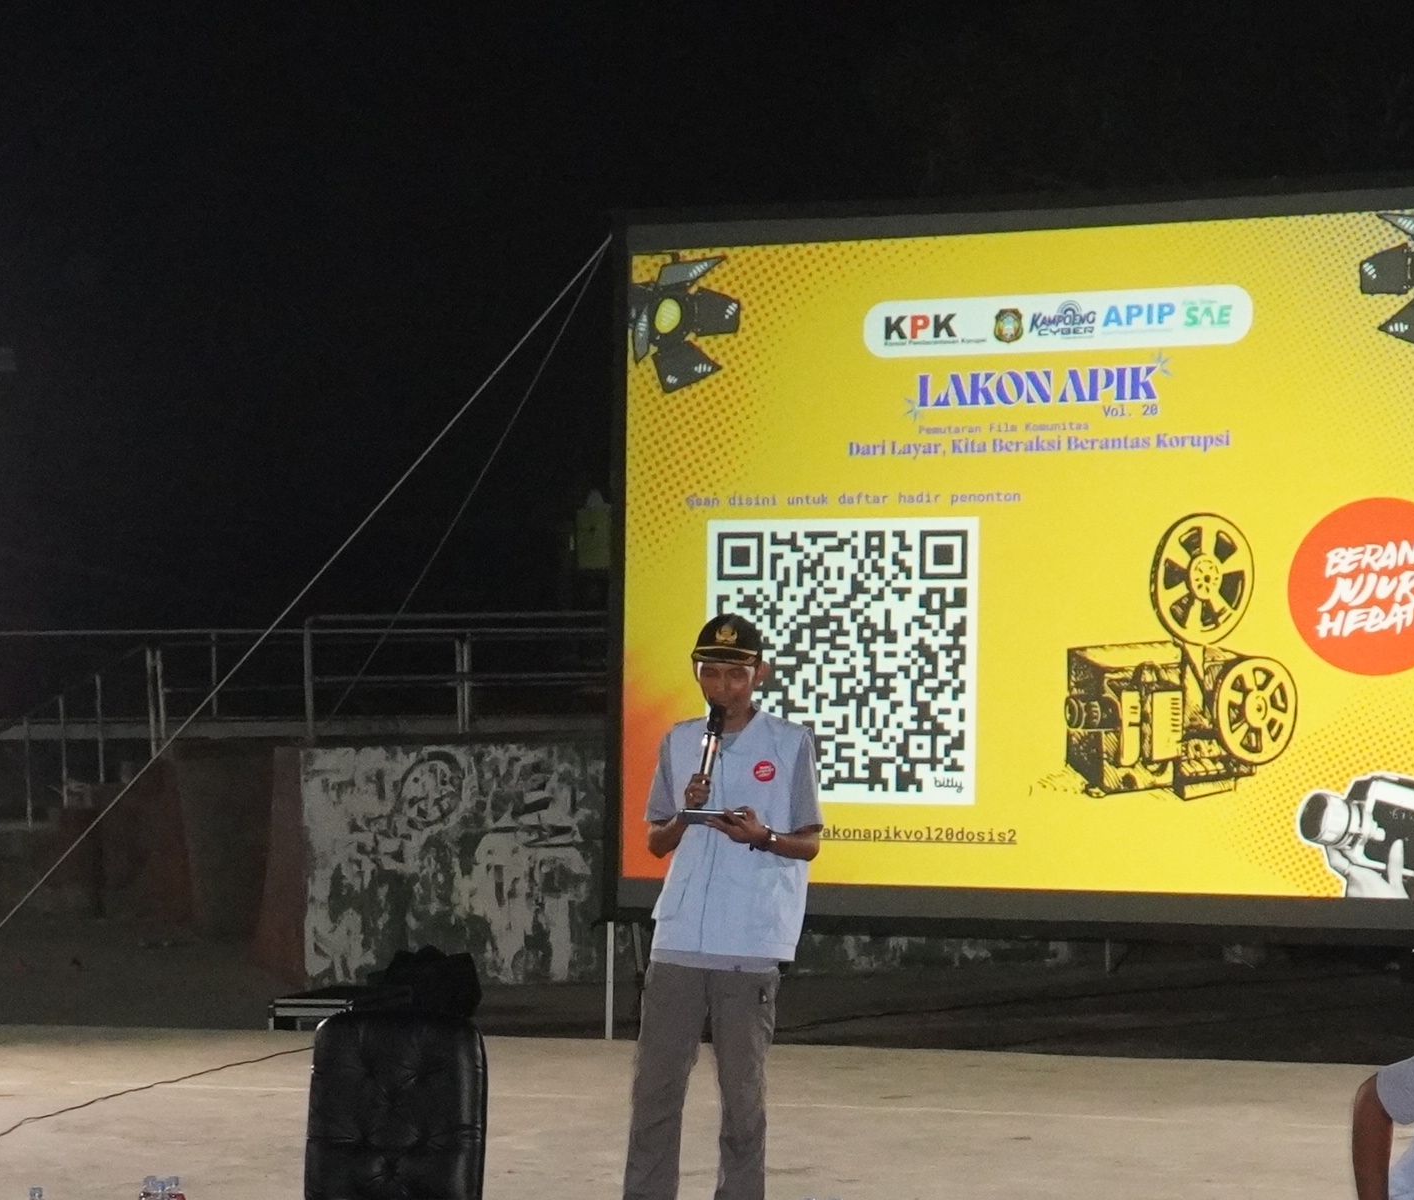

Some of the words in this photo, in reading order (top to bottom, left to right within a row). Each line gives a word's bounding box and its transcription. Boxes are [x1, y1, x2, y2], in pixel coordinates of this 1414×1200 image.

[1029, 308, 1097, 333] KAMPOENG
[1102, 302, 1176, 327] APIP
[1183, 304, 1233, 327] SAE
[884, 313, 957, 340] KPK
[1037, 325, 1095, 337] CYBER
[917, 369, 1053, 407] LAKON
[1057, 365, 1159, 402] APIK
[1102, 405, 1133, 418] Vol.
[1141, 404, 1159, 416] 20
[918, 424, 982, 435] Pemutaran
[989, 423, 1017, 433] Film
[1024, 421, 1089, 432] Komunitas
[848, 440, 886, 456] Dari
[891, 440, 946, 460] Layar,
[951, 437, 987, 454] Kita
[992, 435, 1062, 453] Beraksi
[1066, 434, 1151, 452] Berantas
[1156, 430, 1230, 453] Korupsi
[728, 494, 778, 507] disini
[787, 493, 828, 506] untuk
[838, 492, 888, 505] daftar
[898, 491, 941, 504] hadir
[950, 491, 1021, 506] penonton
[933, 776, 964, 793] bitly
[819, 825, 1017, 844] akonapikvol20dosis2
